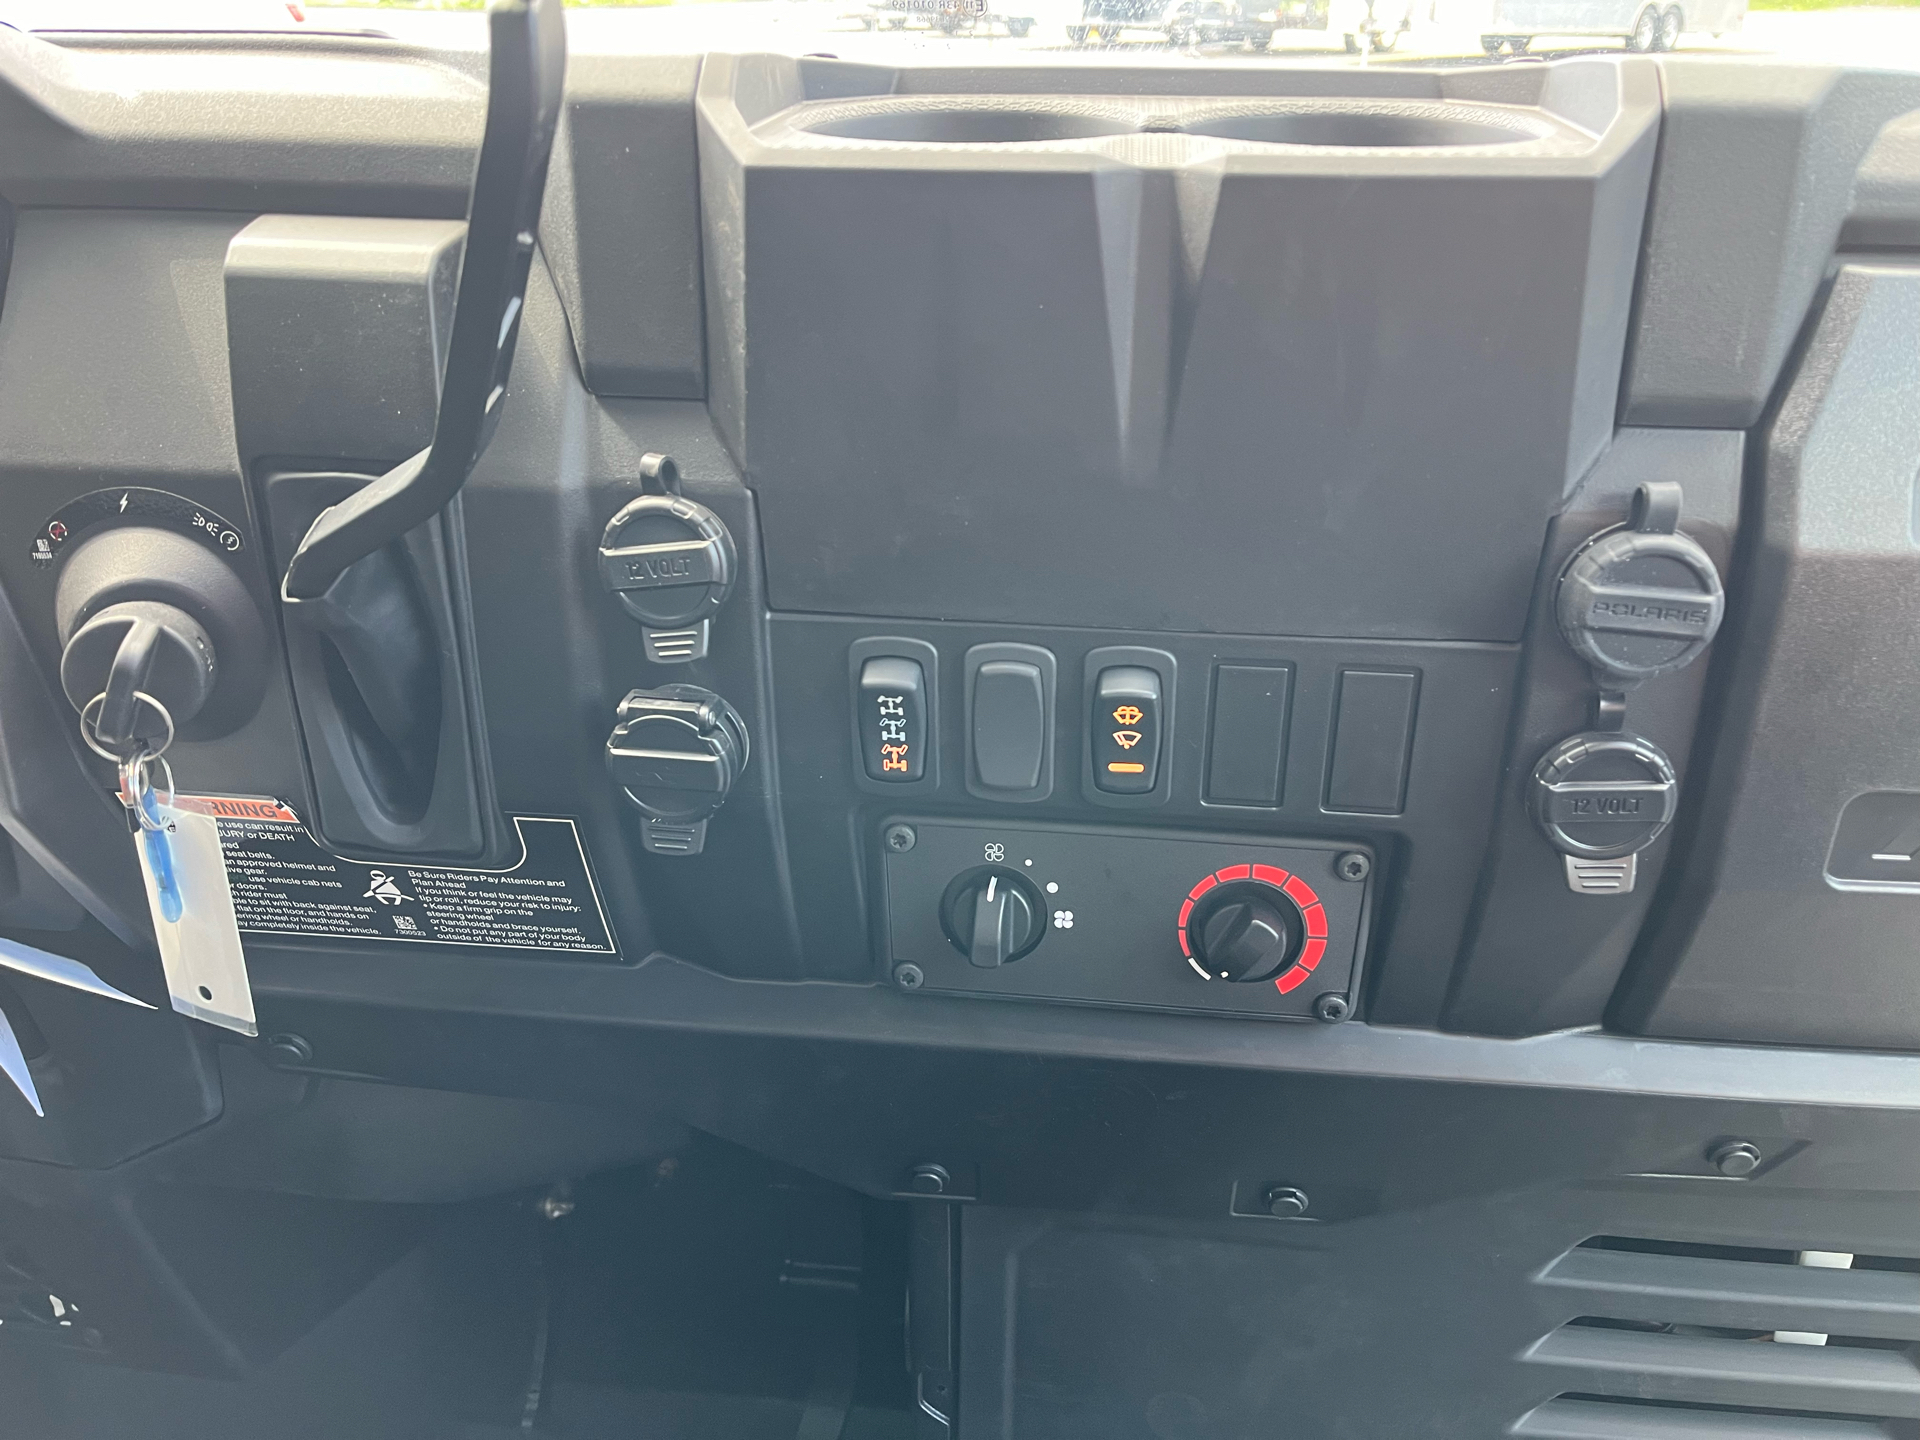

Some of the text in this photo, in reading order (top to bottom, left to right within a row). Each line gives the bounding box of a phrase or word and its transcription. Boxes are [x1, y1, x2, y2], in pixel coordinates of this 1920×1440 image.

[625, 556, 691, 580] 12 VOLT
[1592, 601, 1709, 625] POLARIS
[211, 801, 278, 818] RNING
[1570, 797, 1644, 815] 12 VOLT
[225, 821, 244, 829] use
[245, 822, 264, 831] can
[266, 824, 294, 833] result
[219, 829, 244, 838] JURY
[258, 832, 296, 842] DEATH
[226, 850, 276, 860] seat belts.
[237, 859, 282, 869] approved
[282, 861, 317, 871] helmet
[317, 864, 337, 872] and
[243, 867, 268, 876] gear.
[248, 875, 266, 883] use
[266, 876, 301, 885] vehicle
[301, 878, 320, 887] cab
[321, 880, 343, 888] nets
[408, 870, 566, 888] Be Sure Riders Pay Attention and
[411, 878, 467, 889] Plan Ahead
[236, 882, 268, 891] doors.
[240, 890, 262, 898] rider
[263, 892, 288, 900] must
[418, 894, 432, 902] tip
[463, 898, 498, 906] reduce
[498, 900, 520, 908] your
[442, 888, 467, 896] think
[478, 891, 498, 899] feel
[498, 892, 515, 900] the
[515, 893, 551, 902] vehicle
[551, 896, 572, 905] may
[236, 905, 253, 913] flat
[266, 906, 283, 914] the
[326, 910, 356, 919] hands
[272, 900, 293, 908] with
[292, 900, 317, 909] back
[317, 903, 353, 912] against
[429, 902, 455, 911] Keep
[463, 905, 483, 913] firm
[483, 907, 503, 915] grip
[517, 909, 534, 917] the
[260, 914, 289, 922] wheel
[300, 916, 353, 926] handholds.
[426, 911, 495, 921] steering wheel
[249, 921, 300, 931] completely
[300, 923, 329, 932] inside
[329, 925, 345, 933] the
[345, 926, 382, 935] vehicle.
[440, 918, 492, 929] handholds
[492, 922, 511, 930] and
[511, 923, 539, 932] brace
[539, 926, 582, 934] yourself.
[440, 925, 455, 933] Do
[472, 928, 489, 936] put
[489, 930, 506, 938] any
[528, 931, 538, 939] of
[538, 933, 561, 941] your
[561, 934, 586, 943] body
[436, 933, 472, 941] outside
[484, 935, 501, 943] the
[501, 937, 536, 946] vehicle
[537, 939, 552, 947] for
[552, 941, 570, 949] any
[571, 942, 607, 950] reason.
